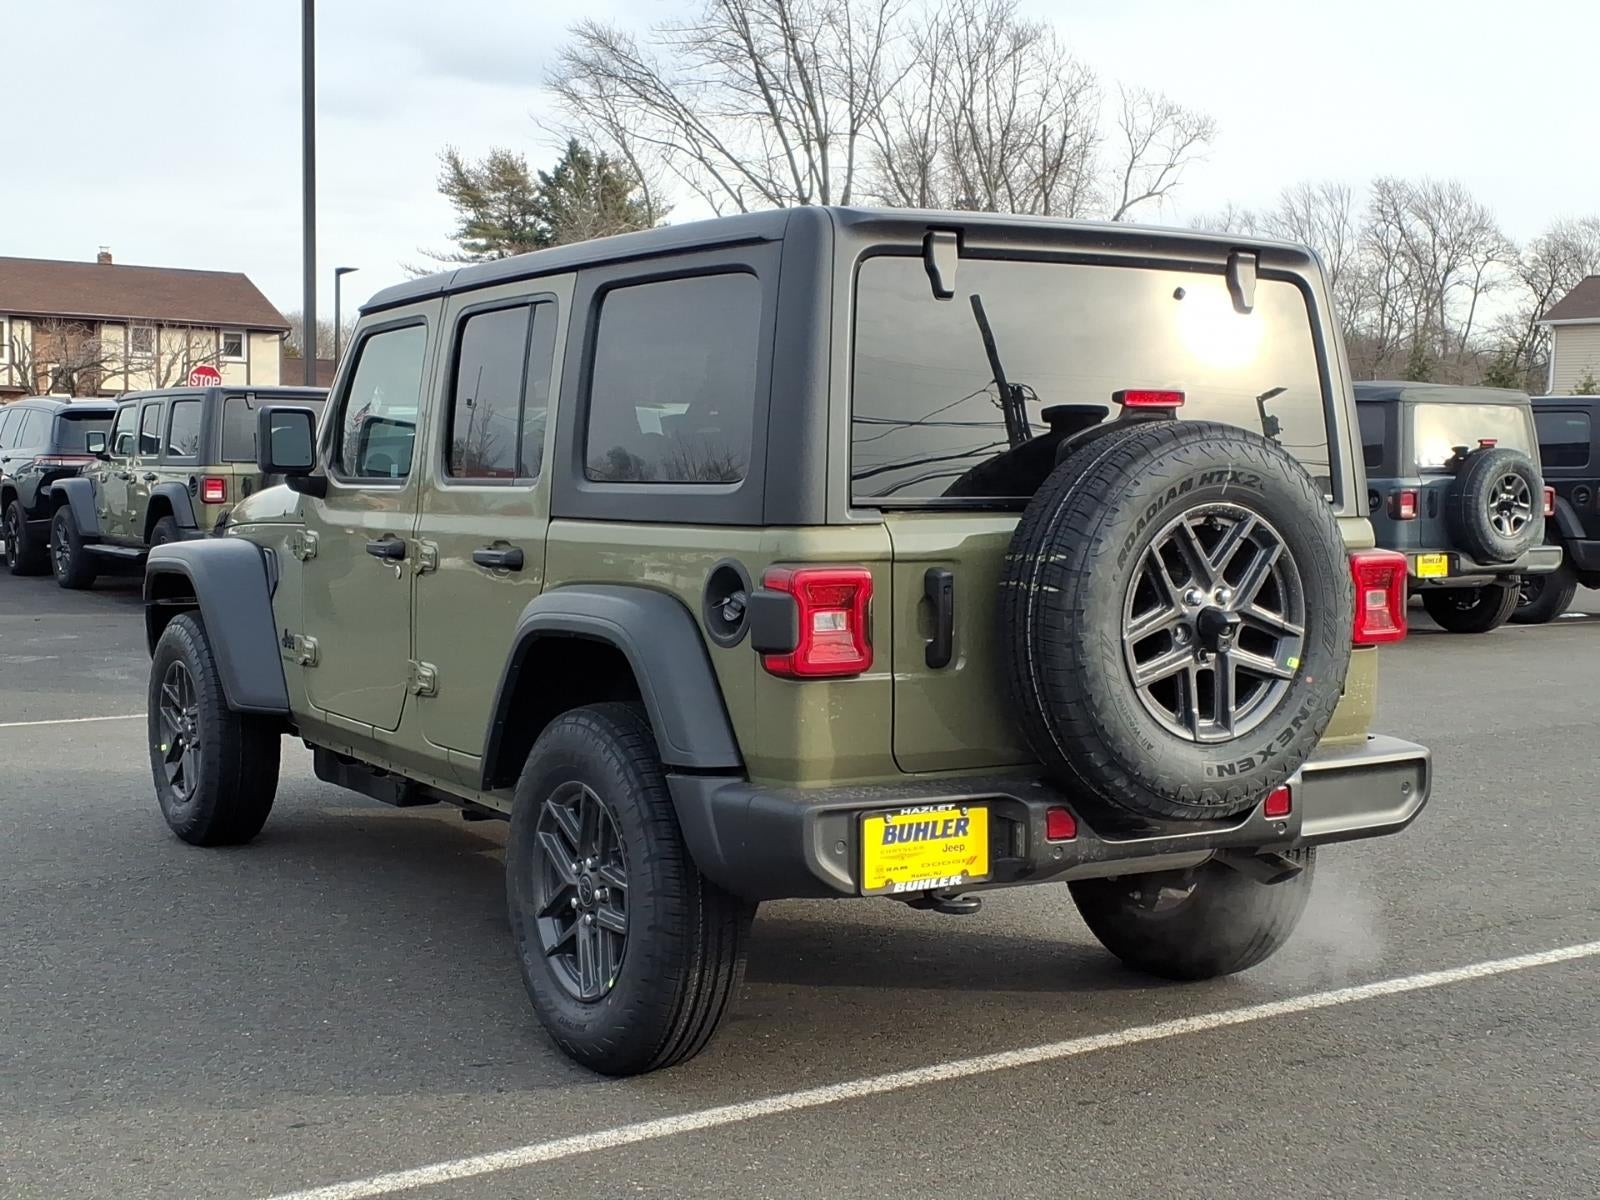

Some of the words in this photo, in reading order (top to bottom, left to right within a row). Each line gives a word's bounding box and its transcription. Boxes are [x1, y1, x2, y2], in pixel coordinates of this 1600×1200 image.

[191, 373, 220, 387] STOP
[1216, 706, 1310, 777] NEXEN
[900, 803, 956, 816] HAZLET
[881, 817, 970, 845] BUHLER
[942, 843, 966, 853] Jeep
[893, 875, 962, 893] BUHLER
